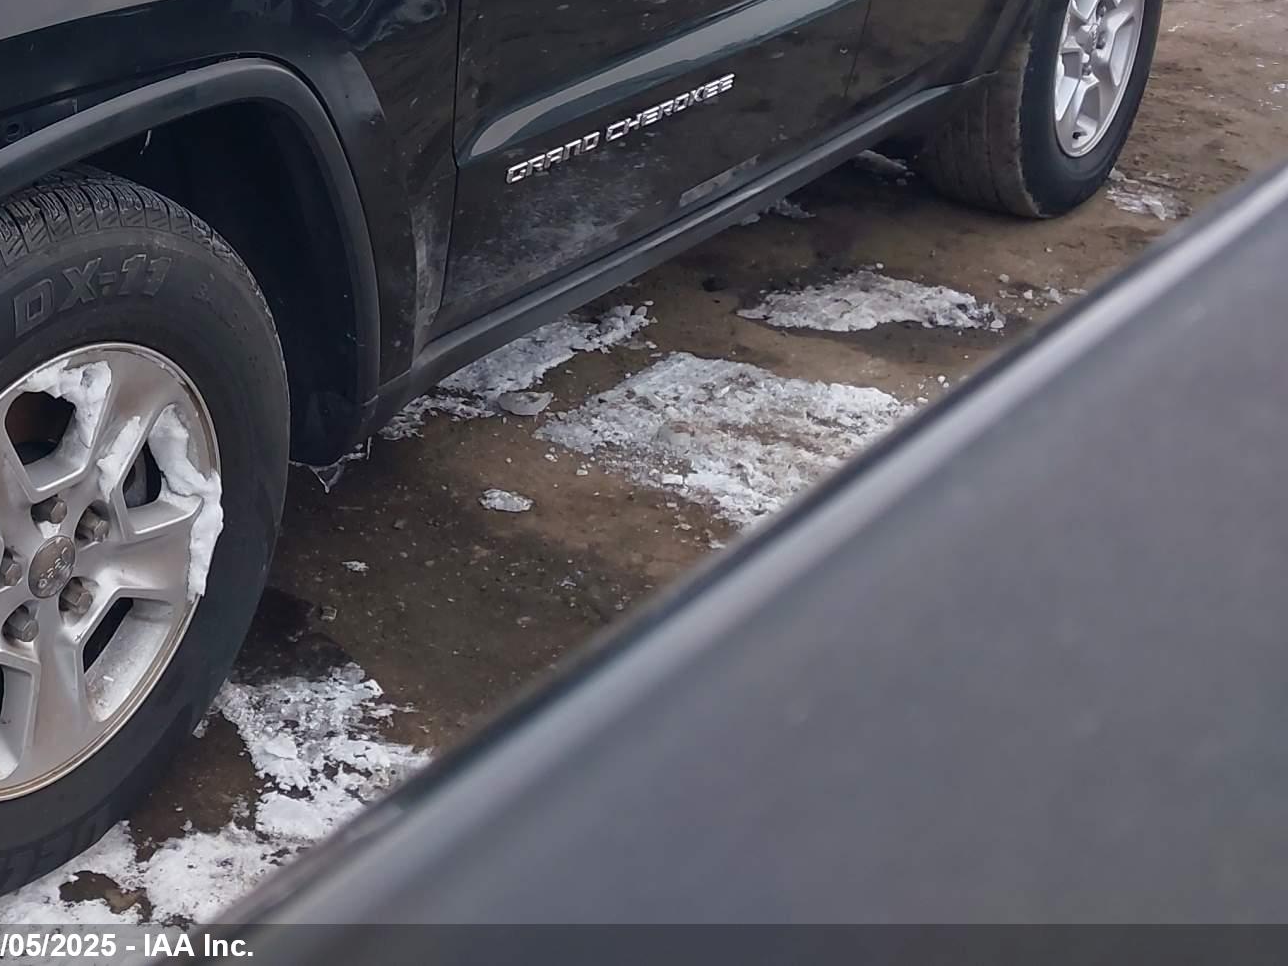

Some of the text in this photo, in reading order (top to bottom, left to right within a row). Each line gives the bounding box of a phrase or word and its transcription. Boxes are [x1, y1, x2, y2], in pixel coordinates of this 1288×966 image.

[506, 73, 736, 184] GRAND CHEROKEE
[13, 253, 172, 338] DX-11
